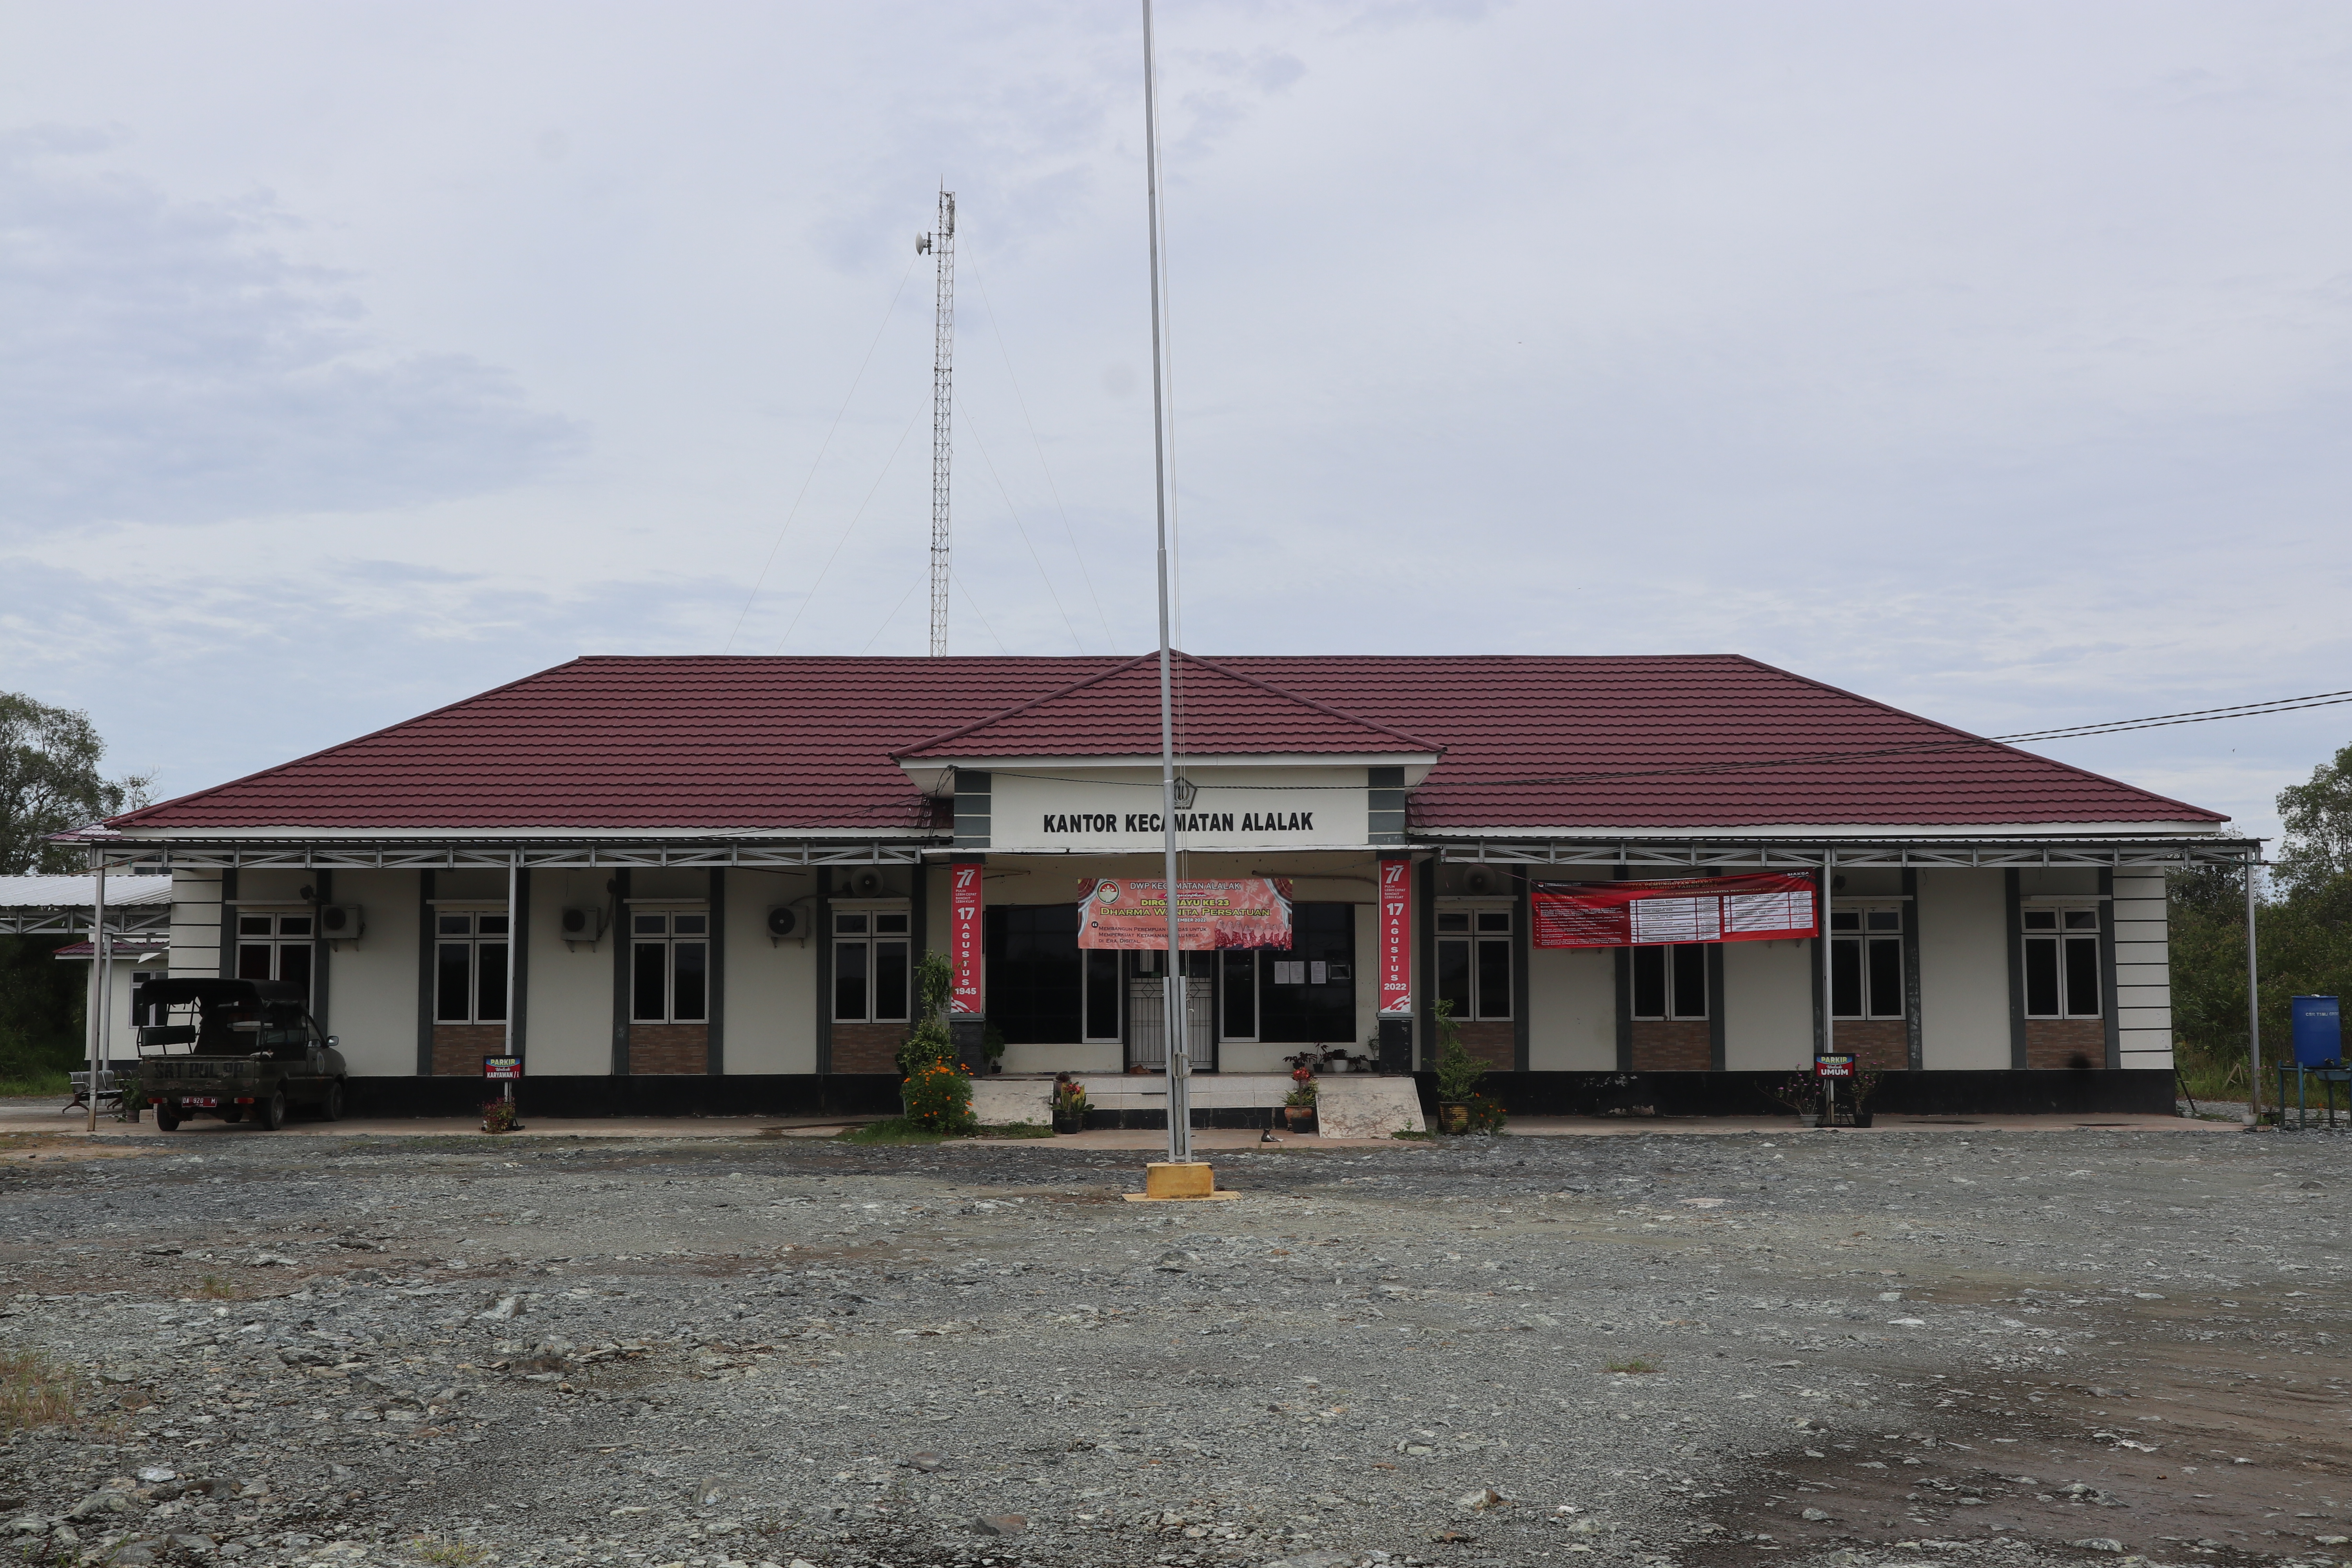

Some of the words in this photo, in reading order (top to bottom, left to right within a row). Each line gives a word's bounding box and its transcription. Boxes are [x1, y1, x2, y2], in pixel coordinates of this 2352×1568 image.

[1044, 814, 1117, 833] KANTOR
[1241, 812, 1313, 831] ALALAK
[956, 869, 975, 888] 77
[1386, 865, 1405, 884] 77
[958, 907, 975, 920] 17
[1100, 907, 1151, 916] DHARMA
[1202, 907, 1270, 916] PERSATUAN
[1386, 903, 1404, 915] 17
[154, 1063, 184, 1078] SAT
[189, 1063, 218, 1078] POL
[223, 1062, 244, 1078] PP
